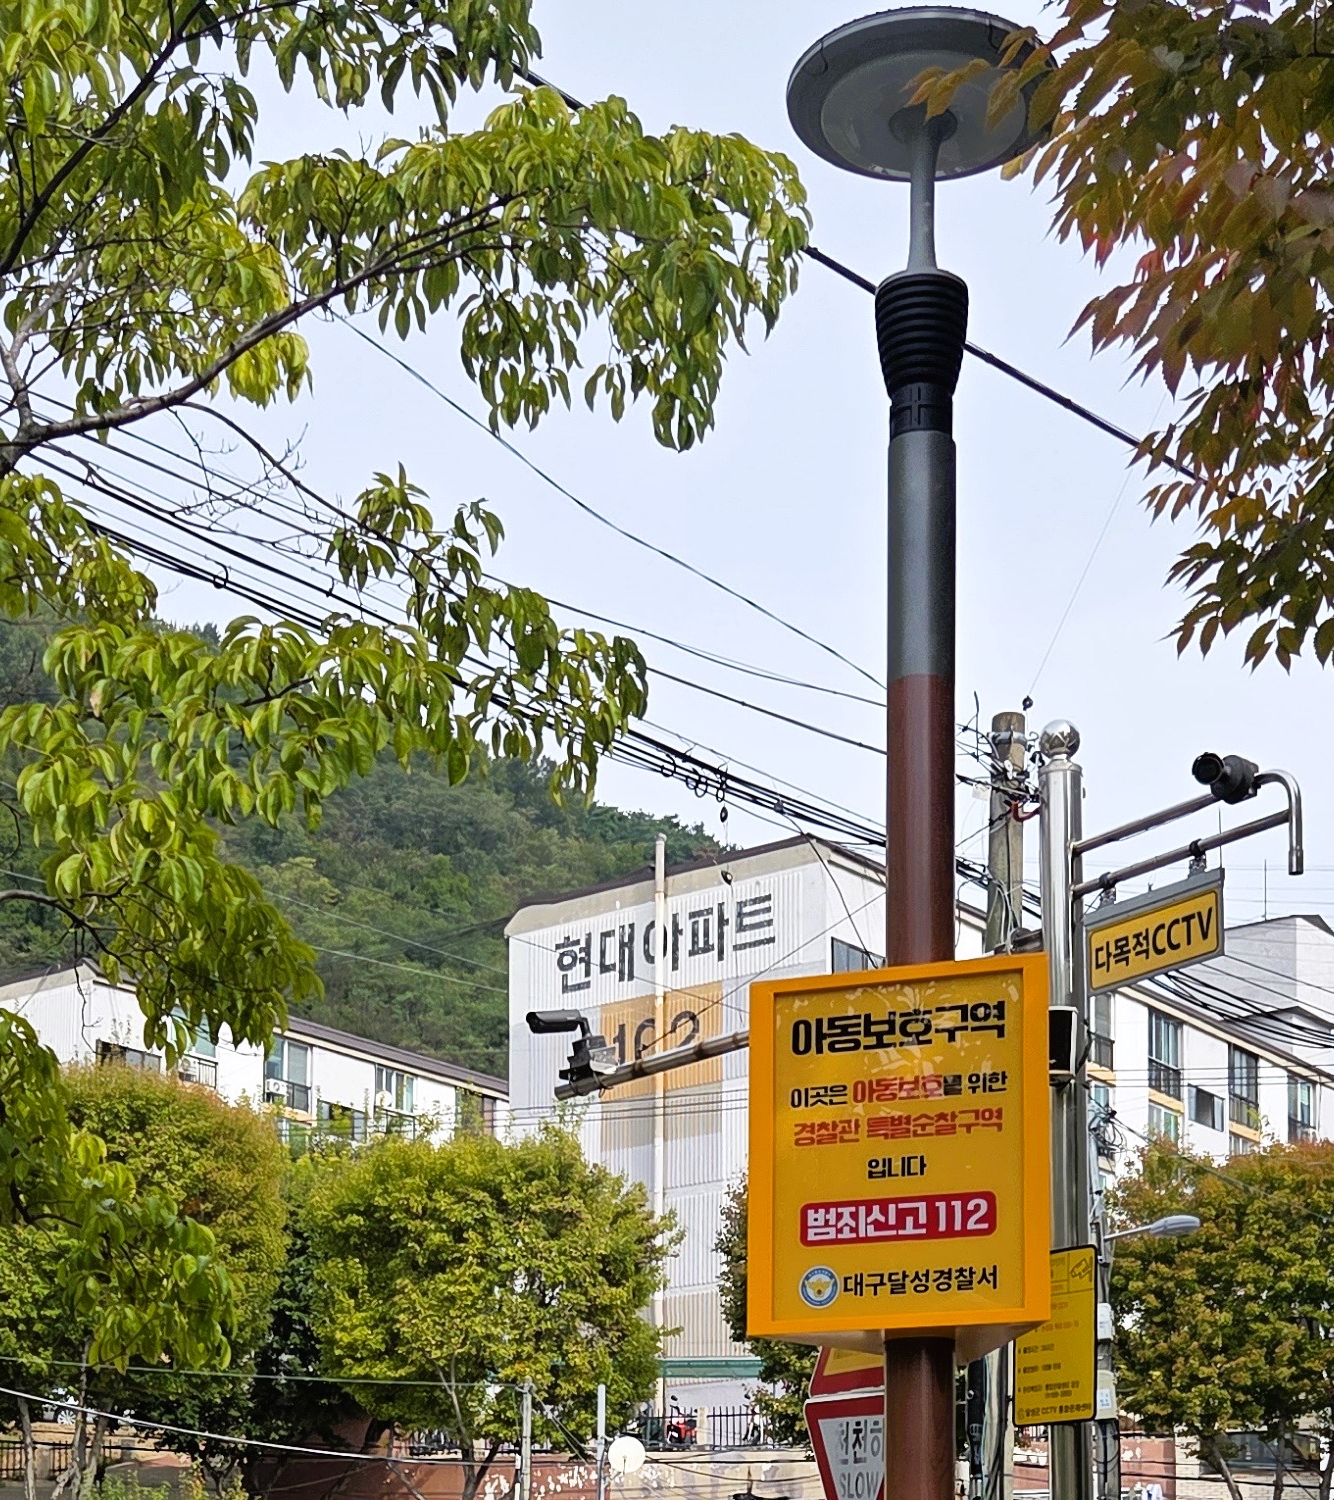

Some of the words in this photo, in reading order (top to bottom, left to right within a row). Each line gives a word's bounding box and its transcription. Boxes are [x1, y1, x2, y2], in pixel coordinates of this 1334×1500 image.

[556, 893, 777, 993] 현대아파트
[1095, 906, 1212, 973] 다목적CCTV
[791, 999, 1006, 1056] 아동보호구역
[790, 1084, 848, 1109] 이곳은
[853, 1074, 963, 1104] 아동보호를
[968, 1071, 1008, 1094] 위한
[794, 1118, 860, 1147] 경찰관
[867, 1107, 1003, 1140] 특별순찰구역
[867, 1155, 927, 1180] 입니다
[806, 1203, 927, 1241] 범죄신고
[936, 1199, 990, 1233] 112
[843, 1265, 998, 1297] 대구달성경찰서
[840, 1471, 879, 1499] SLOW
